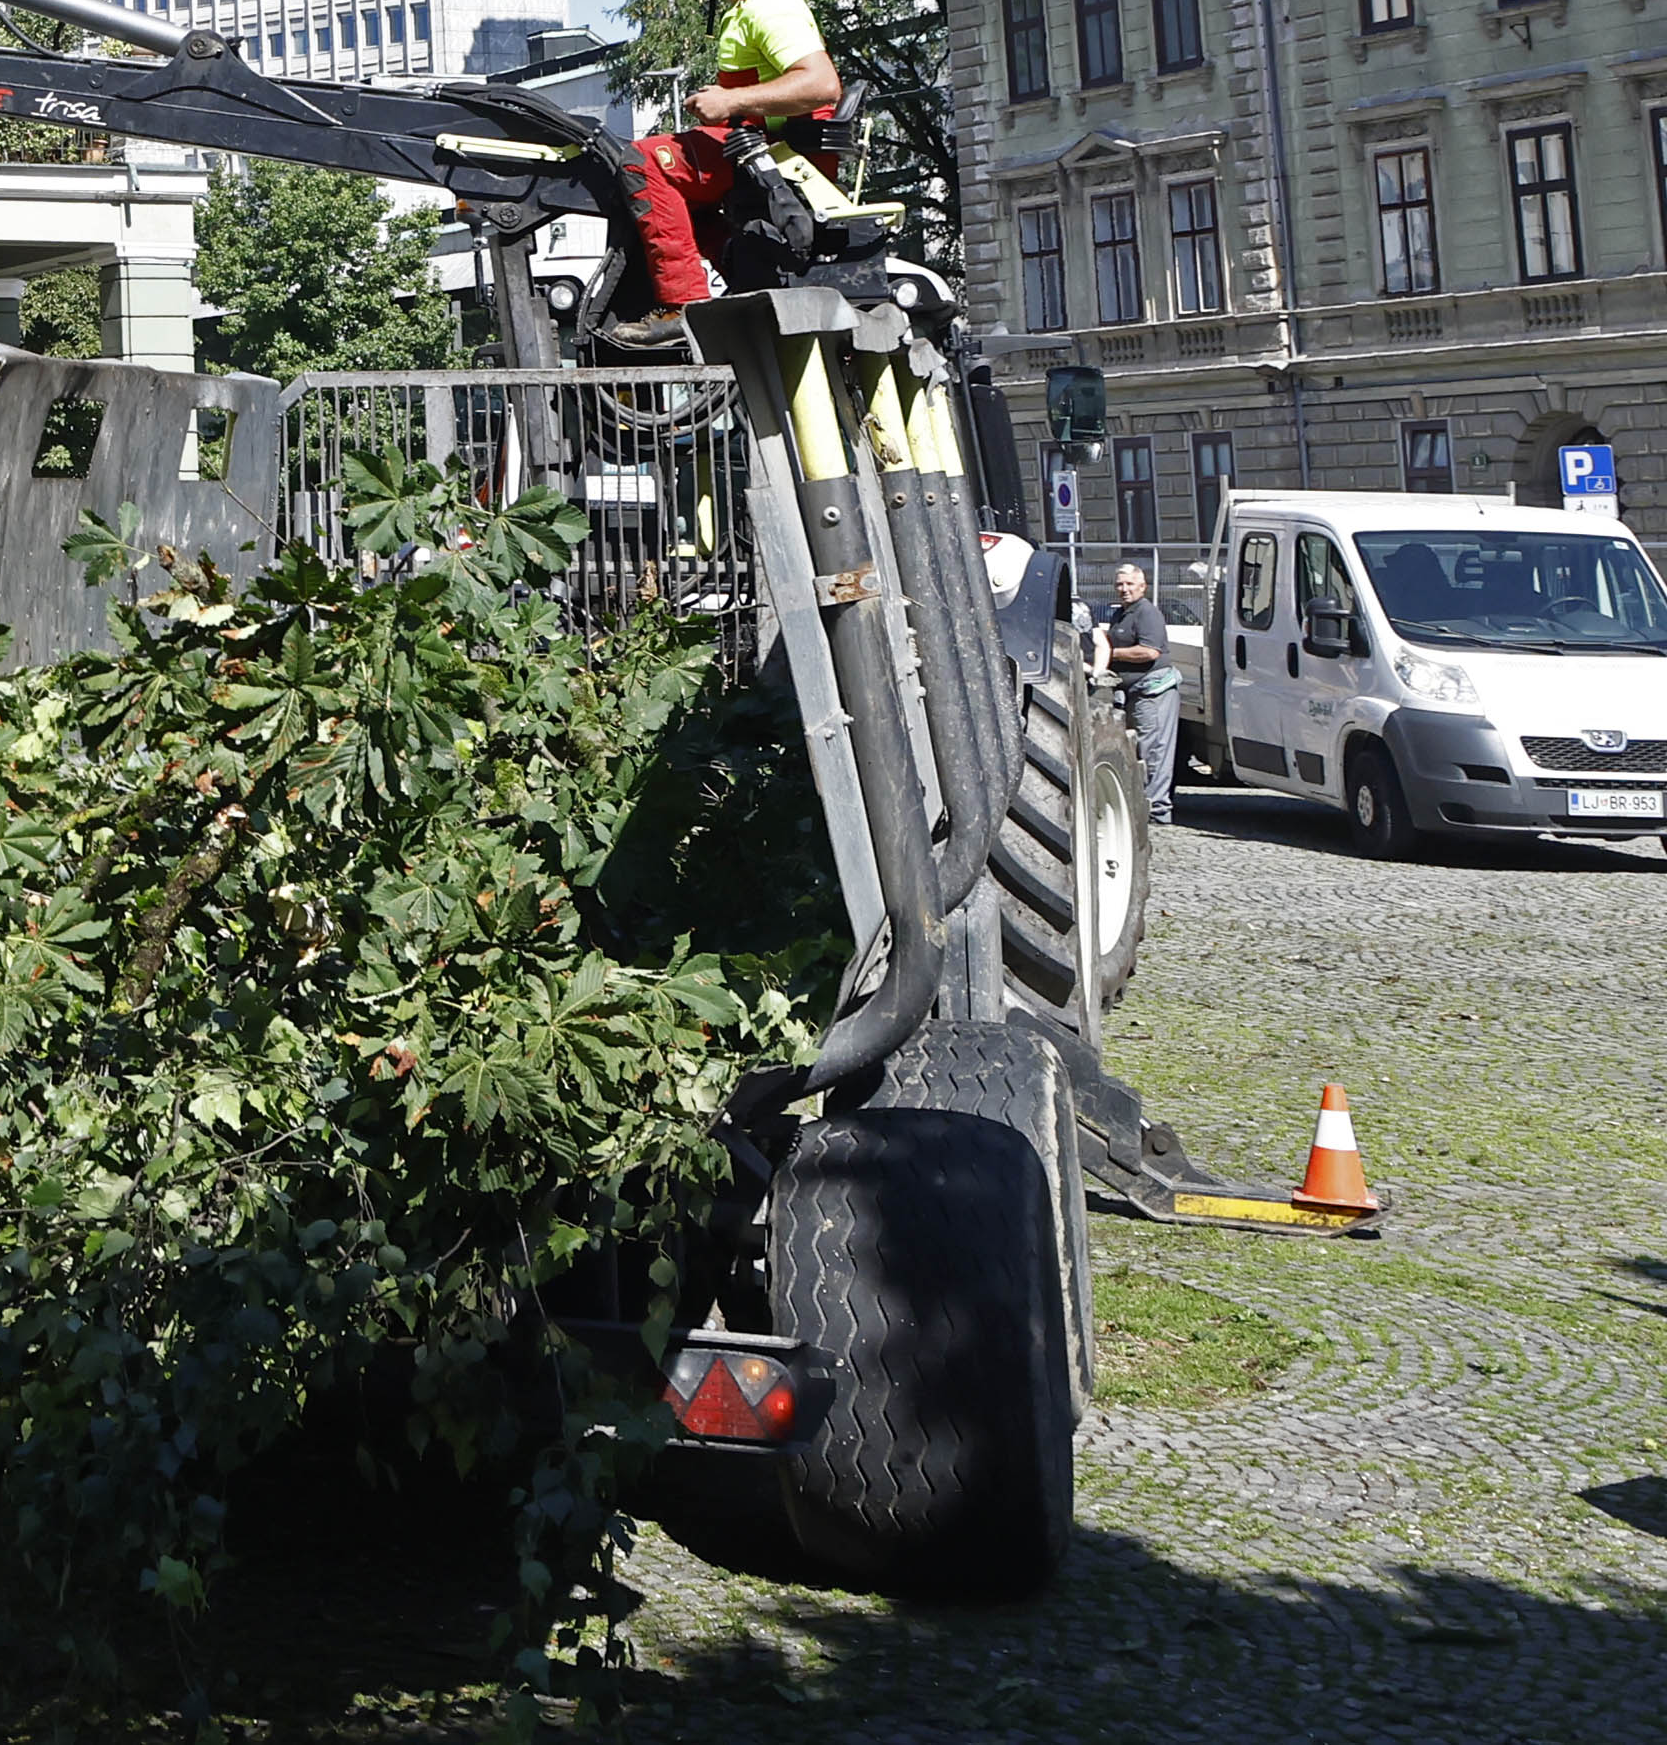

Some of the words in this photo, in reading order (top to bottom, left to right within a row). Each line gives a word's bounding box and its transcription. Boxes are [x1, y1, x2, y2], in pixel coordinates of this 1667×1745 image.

[1565, 451, 1594, 486] P
[1582, 795, 1599, 809] LJ
[1610, 795, 1657, 811] BR-953
